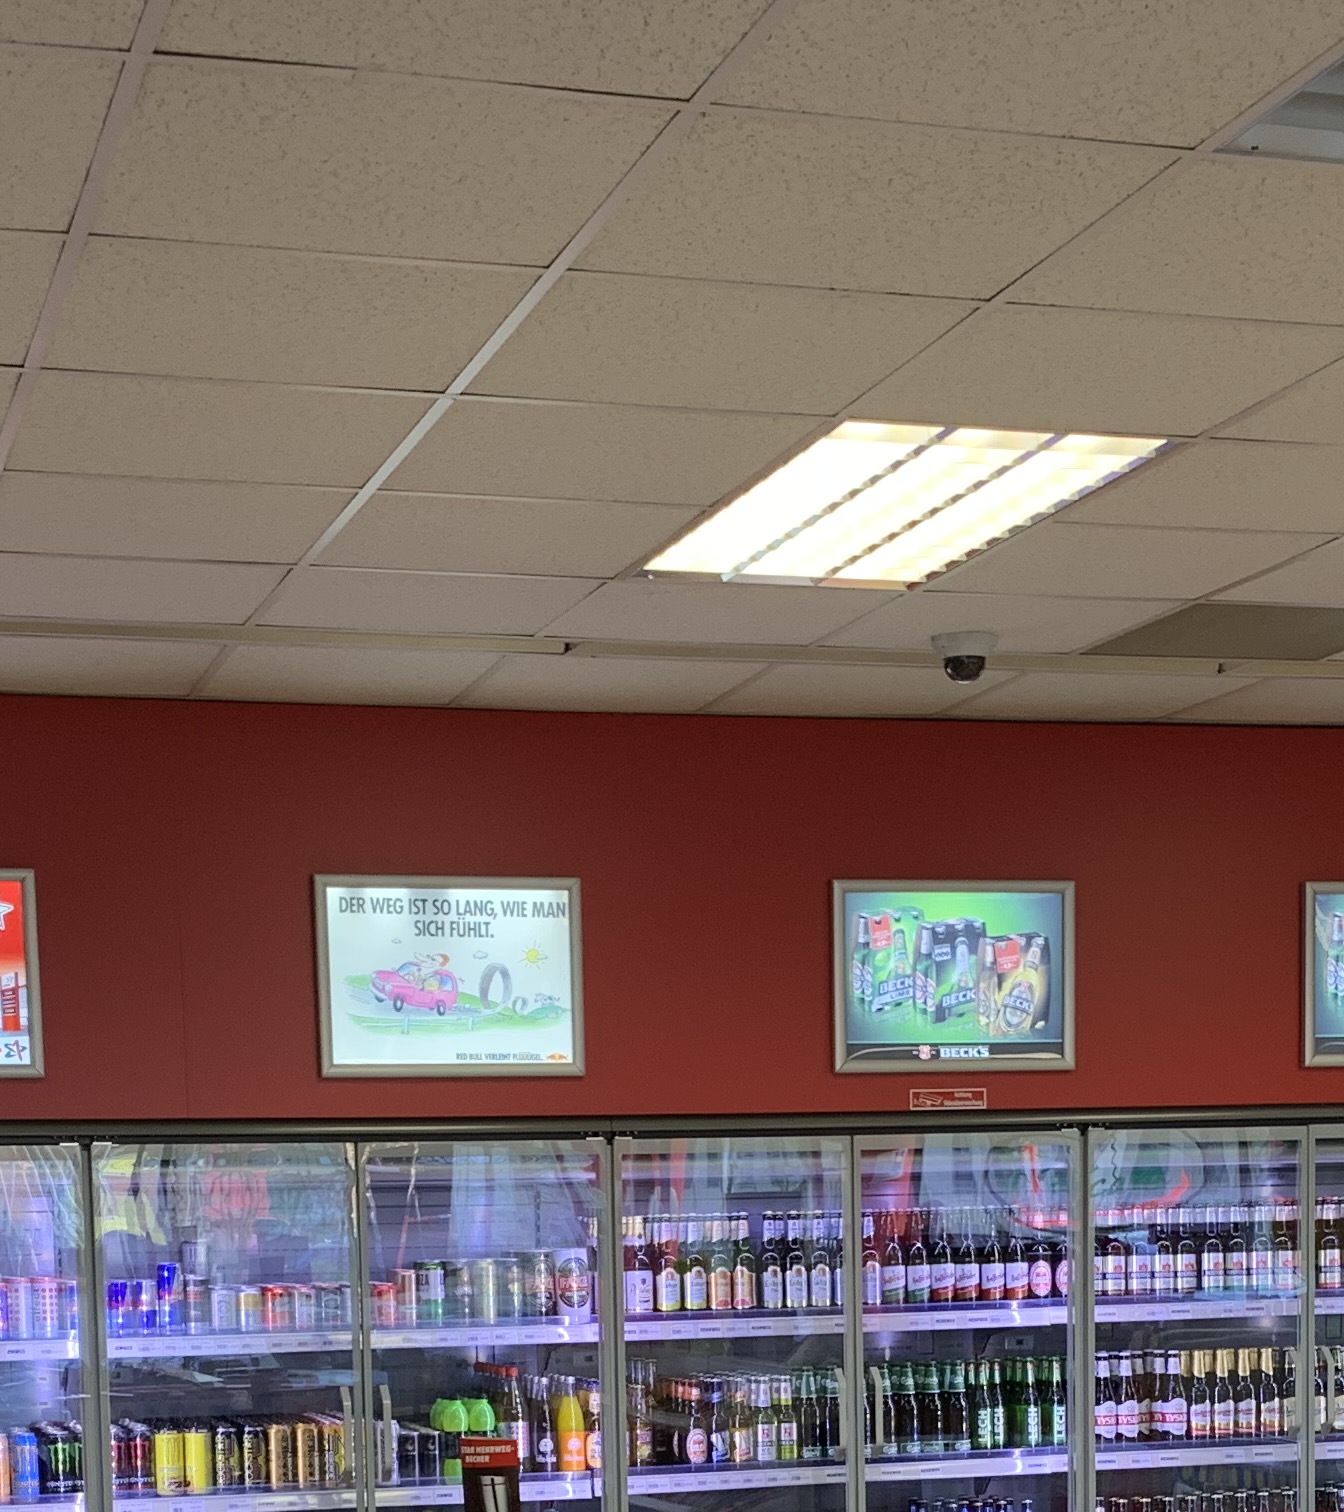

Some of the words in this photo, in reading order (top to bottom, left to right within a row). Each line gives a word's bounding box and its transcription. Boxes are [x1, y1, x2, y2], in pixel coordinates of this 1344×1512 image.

[338, 896, 366, 914] DER
[370, 897, 404, 915] WEG
[408, 898, 428, 915] IST
[432, 899, 451, 916] SO
[455, 899, 498, 920] LANG,
[501, 901, 527, 918] WIE
[532, 901, 566, 919] MAN
[414, 919, 445, 938] SICH
[449, 917, 495, 939] FÜHLT.
[879, 976, 913, 994] BECK
[942, 990, 976, 1007] BECK
[939, 1045, 990, 1058] BECK'S
[977, 1408, 989, 1443] LECH
[993, 1407, 1004, 1441] LECH
[1055, 1406, 1066, 1438] LECH
